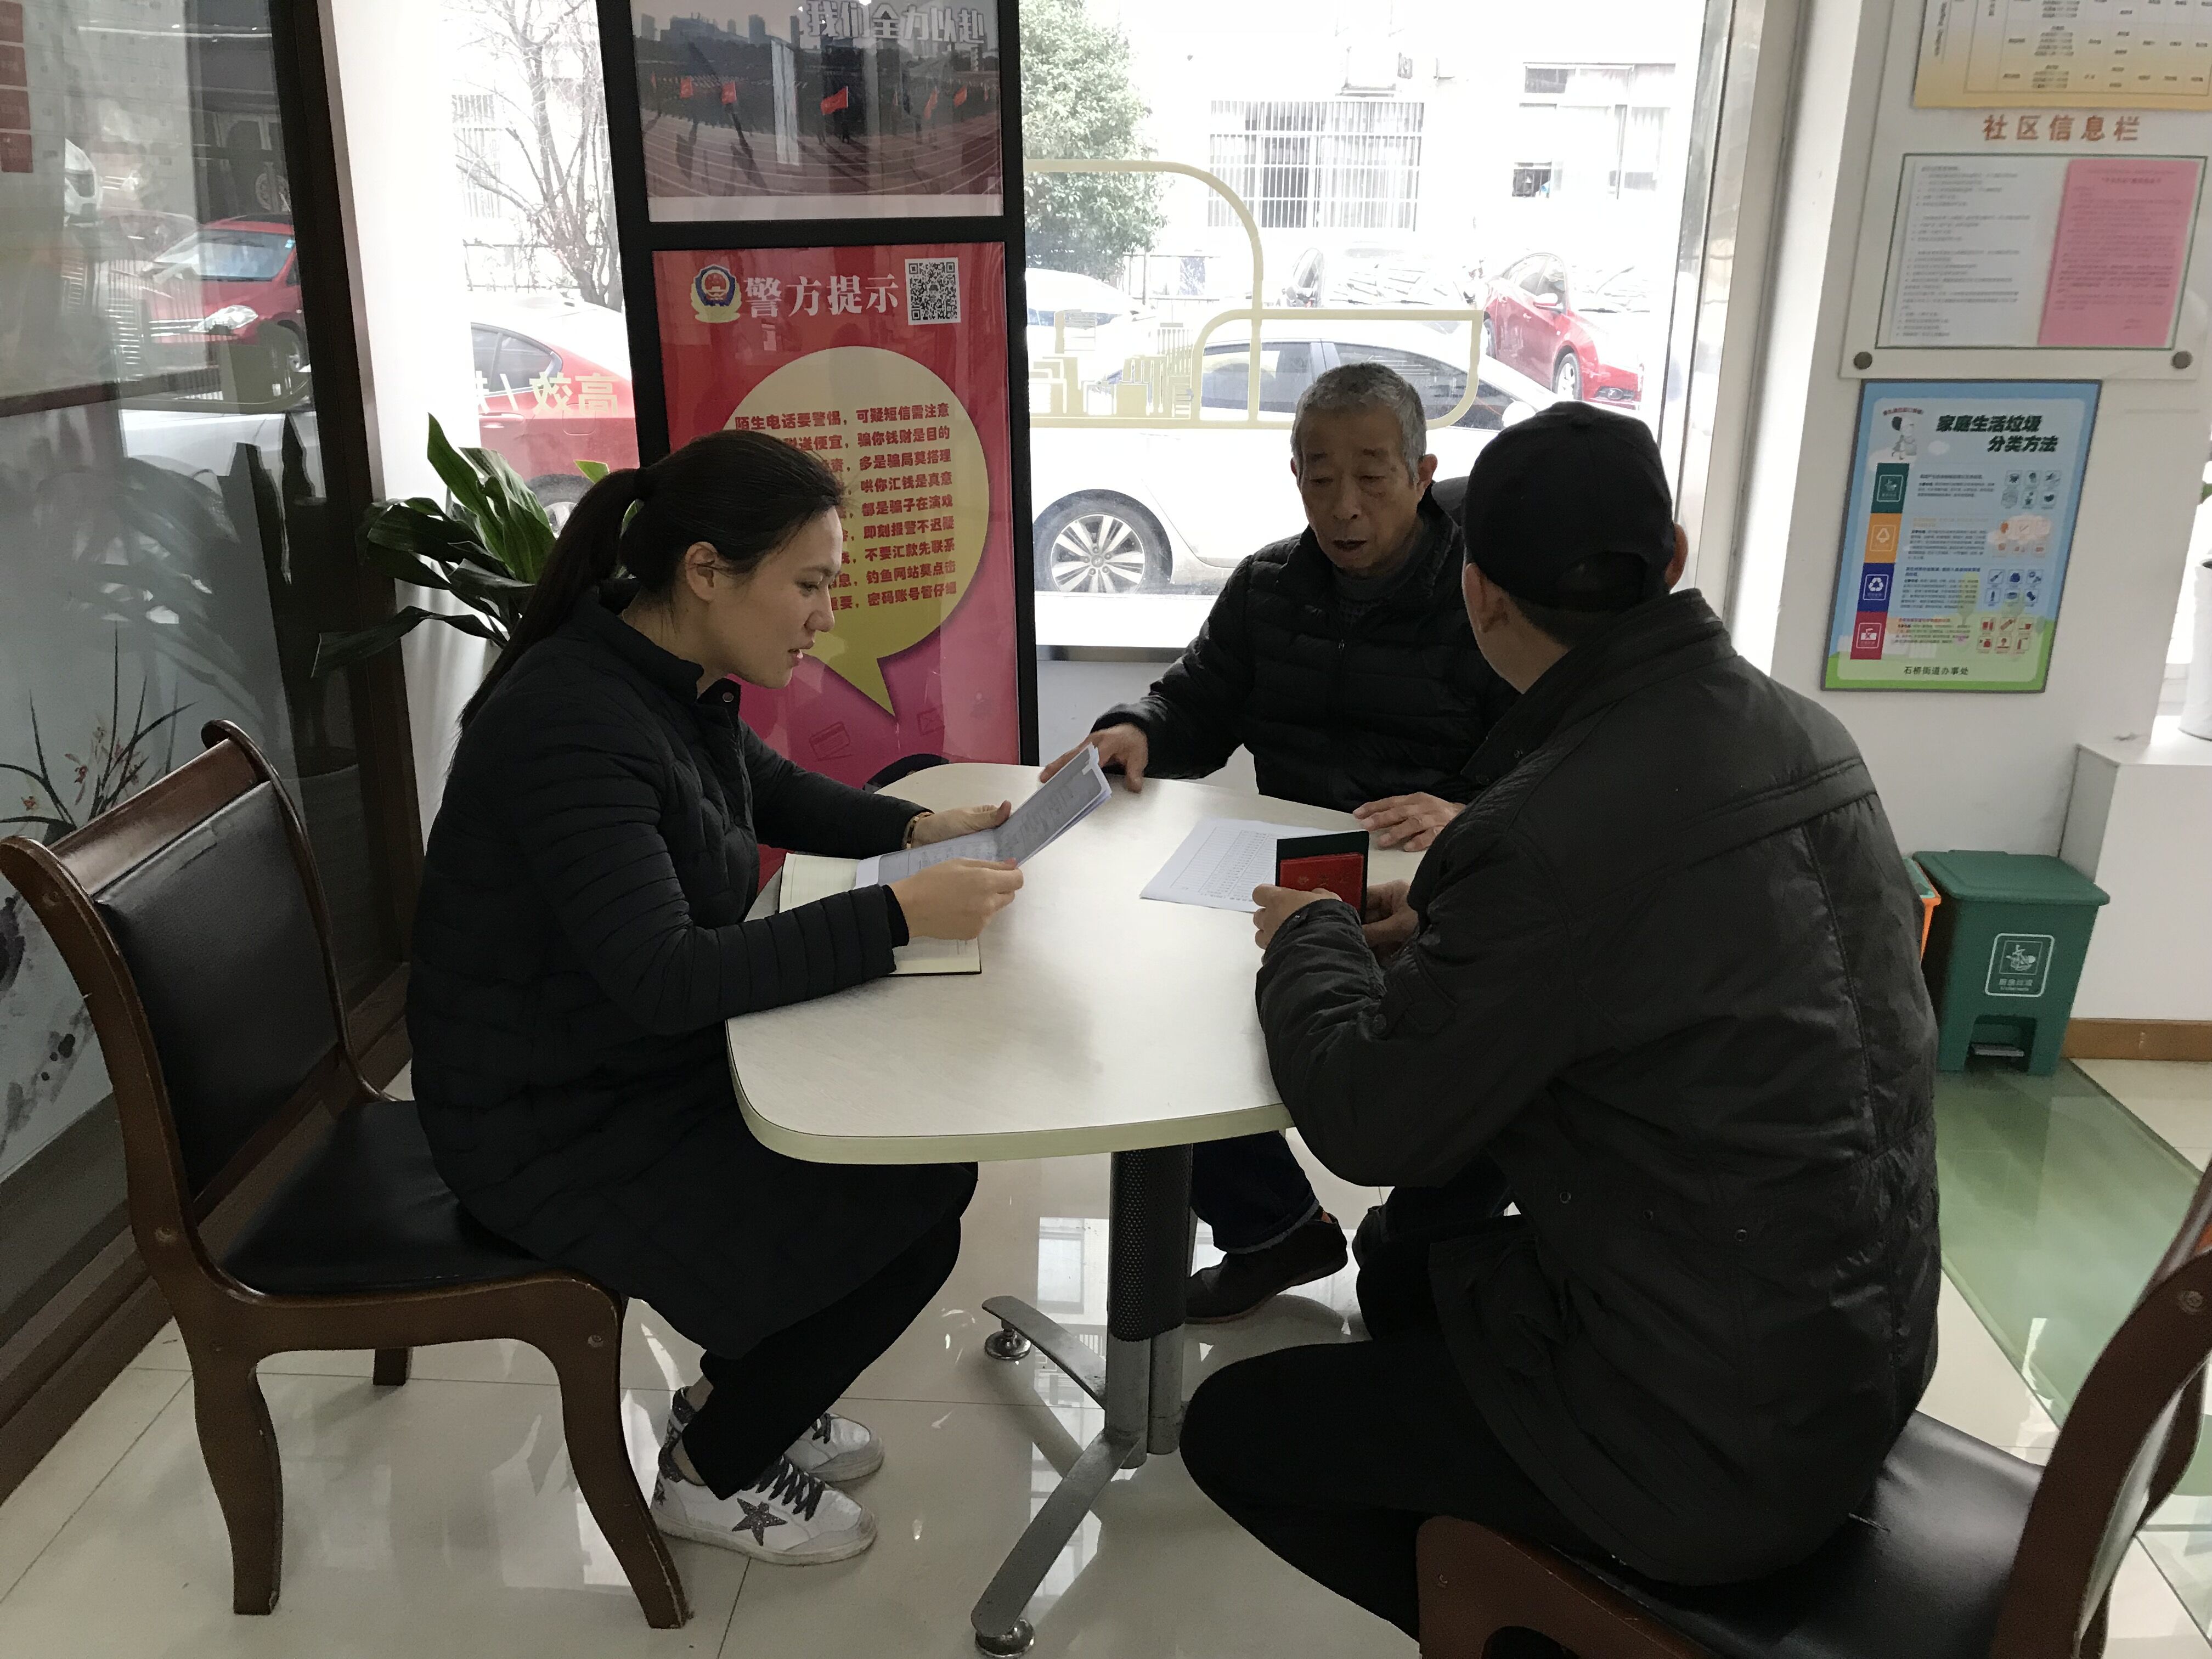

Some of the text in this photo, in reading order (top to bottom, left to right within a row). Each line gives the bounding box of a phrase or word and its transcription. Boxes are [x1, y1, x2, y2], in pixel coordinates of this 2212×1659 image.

[806, 0, 984, 44] 我们全力以赴
[1983, 114, 2140, 141] 社区信息栏
[743, 273, 899, 318] 警方提示
[1936, 415, 2042, 432] 家庭生活垃圾
[1987, 435, 2058, 453] 分类方法
